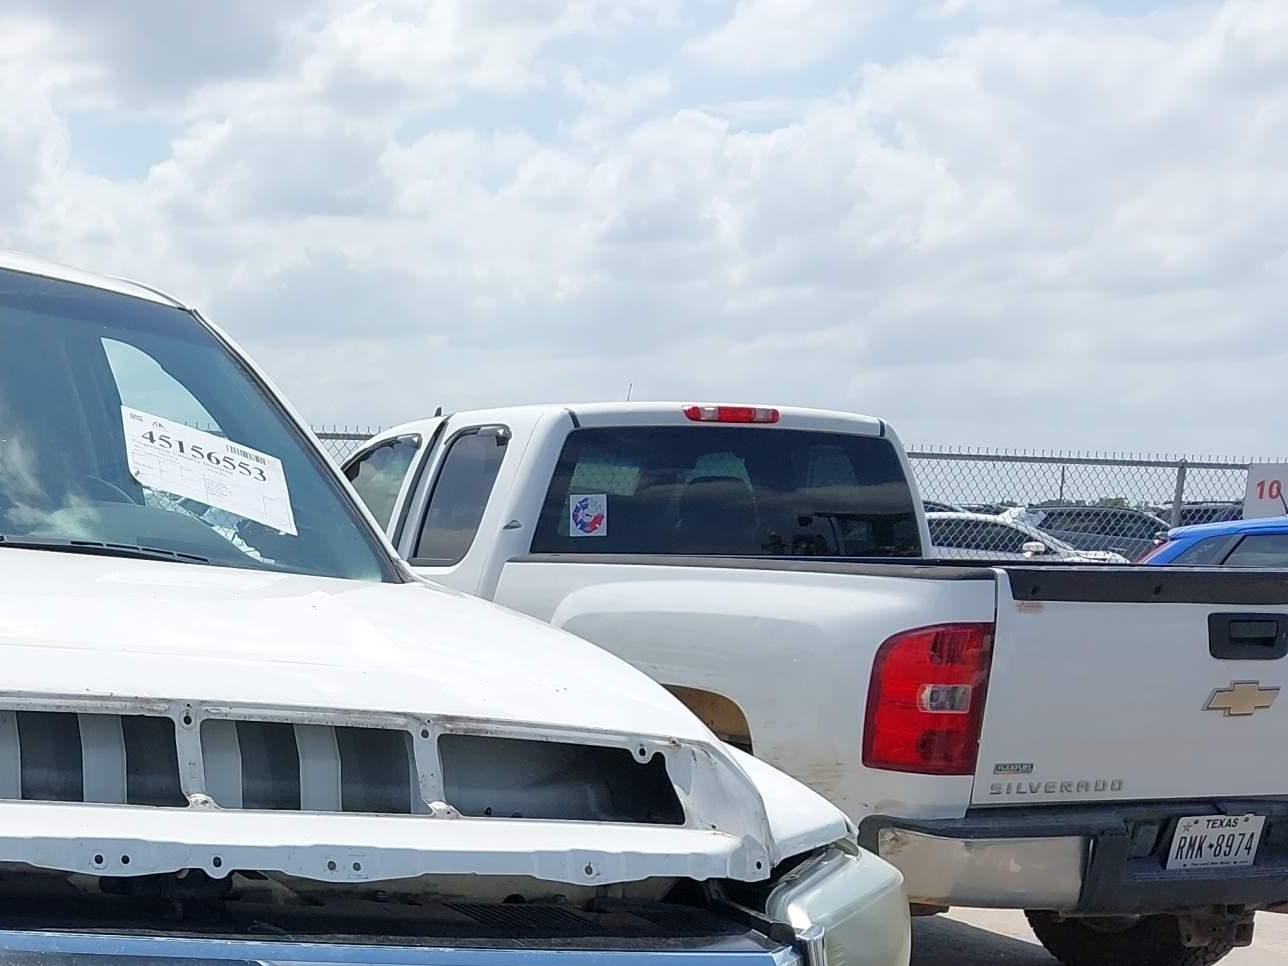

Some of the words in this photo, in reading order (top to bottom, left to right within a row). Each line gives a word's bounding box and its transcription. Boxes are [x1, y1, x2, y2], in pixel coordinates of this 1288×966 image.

[141, 430, 267, 482] 45156553
[989, 779, 1124, 795] SILVERADO
[1206, 818, 1239, 829] TEXAS
